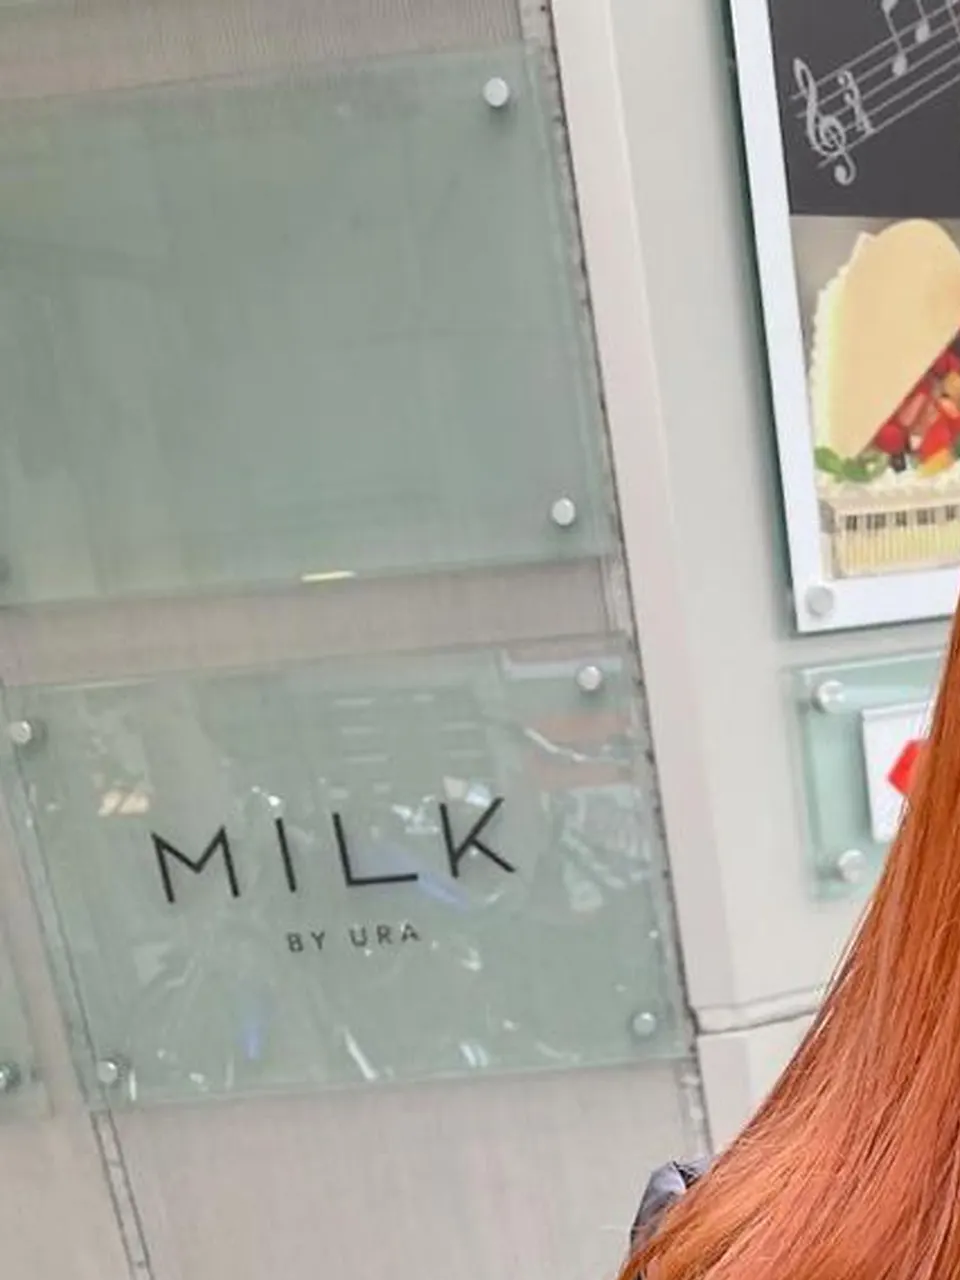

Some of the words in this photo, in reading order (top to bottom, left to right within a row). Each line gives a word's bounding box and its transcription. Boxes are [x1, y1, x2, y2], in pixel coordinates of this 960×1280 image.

[151, 796, 516, 903] MILK
[286, 931, 326, 953] BY
[348, 923, 421, 947] URA
